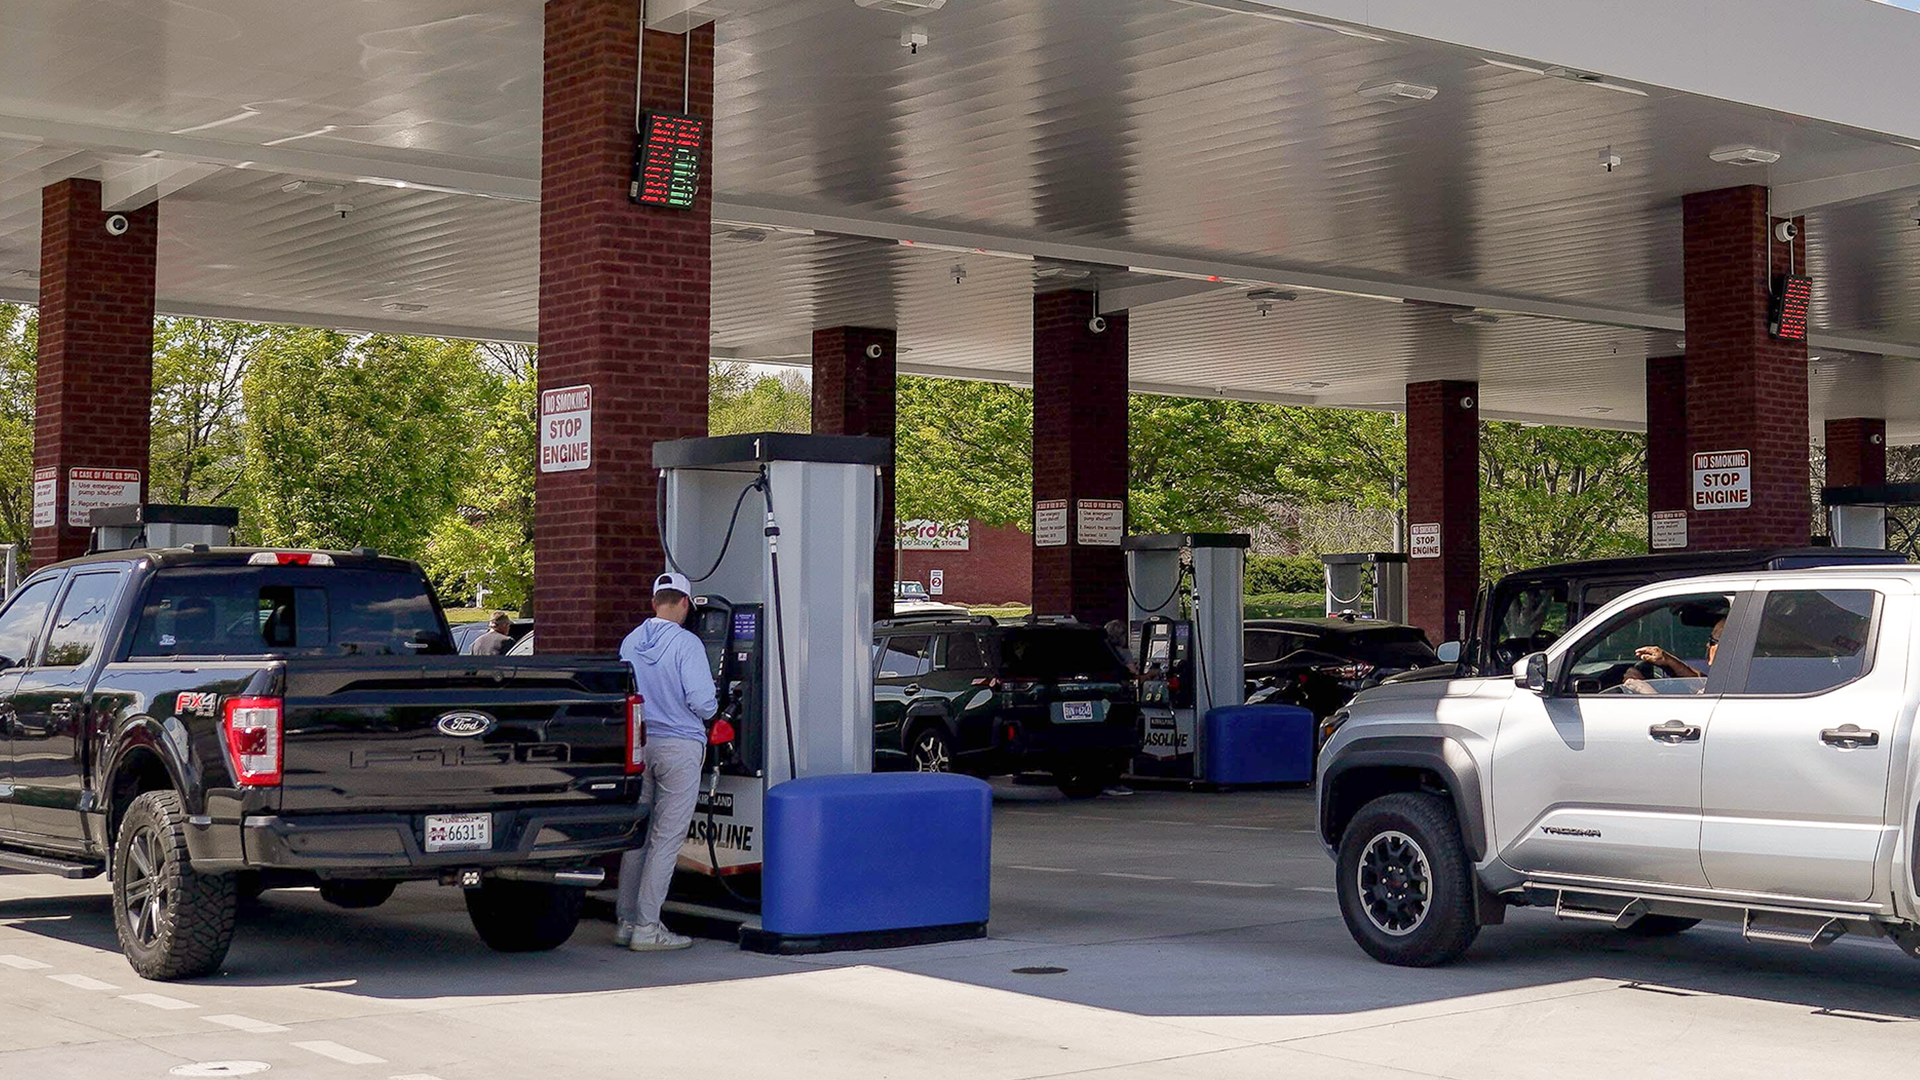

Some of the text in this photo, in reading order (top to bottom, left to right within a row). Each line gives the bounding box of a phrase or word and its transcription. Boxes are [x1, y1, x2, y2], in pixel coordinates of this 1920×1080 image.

[545, 391, 588, 412] NO SMOKING
[550, 417, 582, 440] STOP
[543, 442, 588, 465] ENGINE
[753, 437, 760, 459] 1
[1697, 454, 1746, 469] NO SMOKING
[79, 471, 93, 479] CASE
[102, 471, 114, 480] FIRE
[124, 473, 138, 481] SPILL
[1703, 472, 1740, 487] STOP
[78, 500, 98, 508] Report
[1696, 489, 1748, 505] ENGINE
[1416, 536, 1435, 545] STOP
[1412, 546, 1439, 555] ENGINE
[175, 691, 217, 715] FX4
[450, 717, 480, 730] Ford
[1143, 732, 1188, 748] ASOLINE
[699, 795, 732, 807] KIRLAND
[449, 825, 476, 841] 6631
[685, 820, 753, 851] ASOLINE
